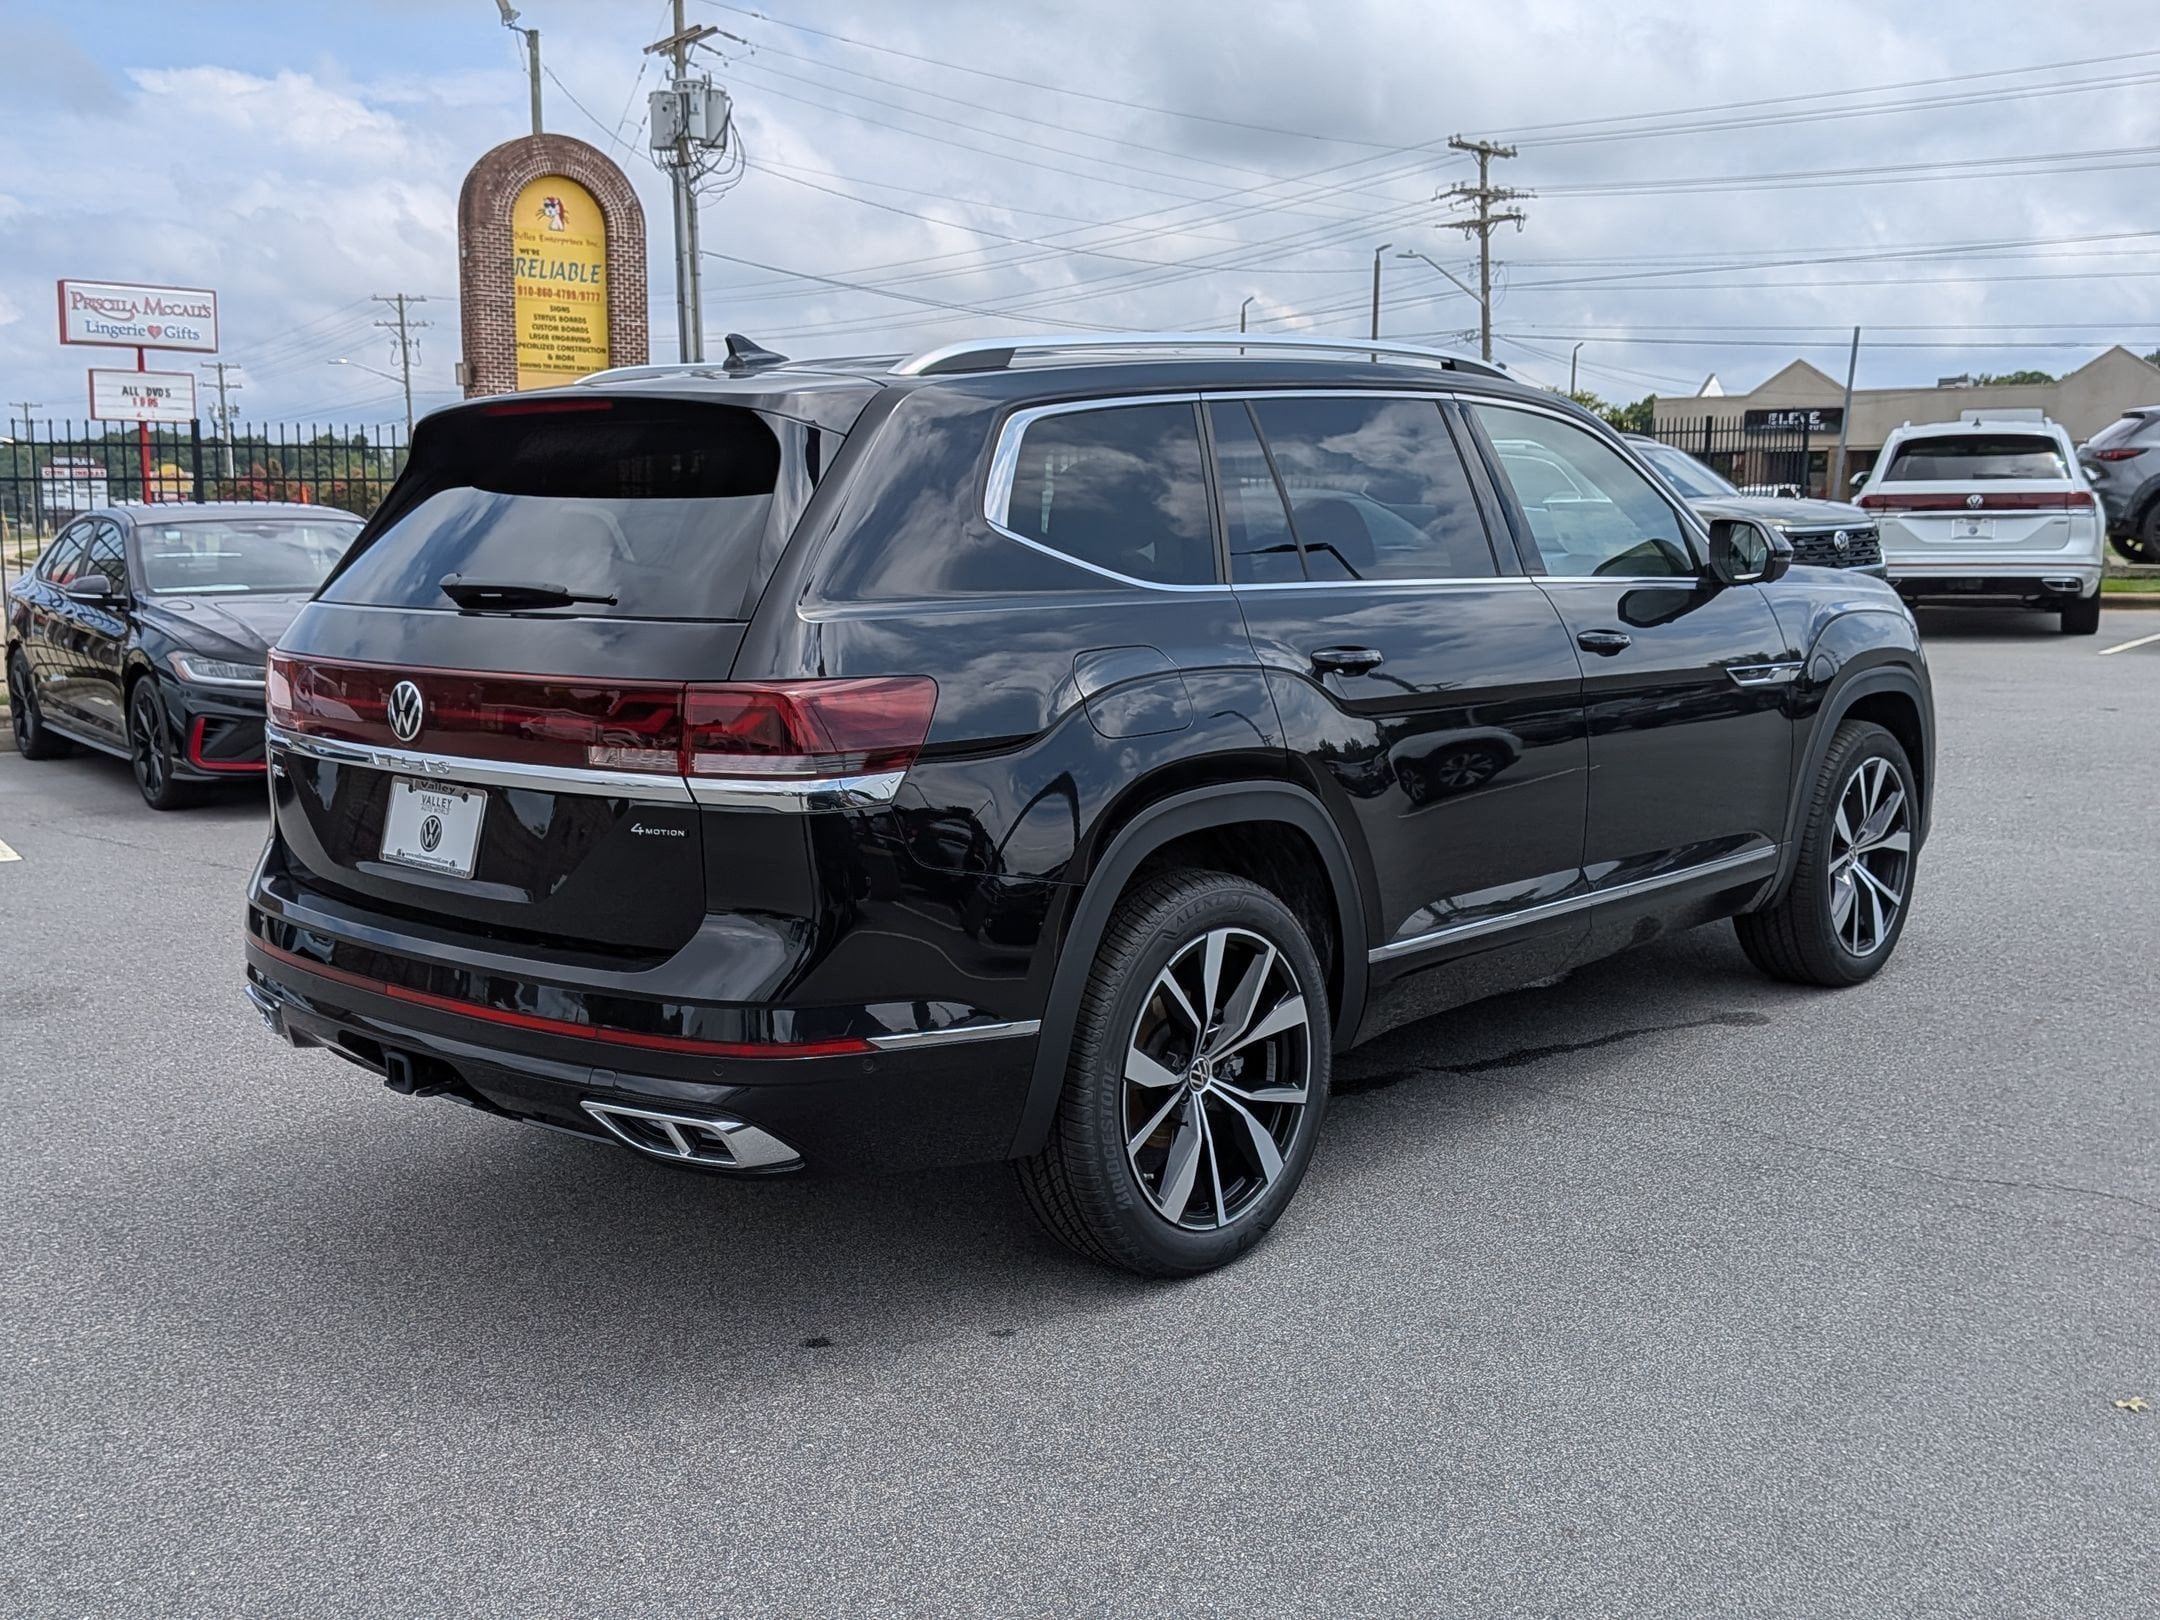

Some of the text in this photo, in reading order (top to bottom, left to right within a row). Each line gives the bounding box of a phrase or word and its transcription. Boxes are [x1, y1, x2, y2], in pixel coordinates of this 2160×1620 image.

[514, 257, 602, 284] RELIABLE
[70, 290, 140, 321] PRISCILLA
[549, 304, 571, 314] SIGNS
[533, 313, 587, 325] STATUS BOARDS
[85, 319, 201, 341] Lingerie Gifts
[531, 323, 590, 334] CUSTOM BOARDS
[121, 385, 139, 397] ALL
[421, 781, 456, 796] Valley
[421, 793, 453, 810] VALLEY
[630, 822, 686, 838] 4MOTION
